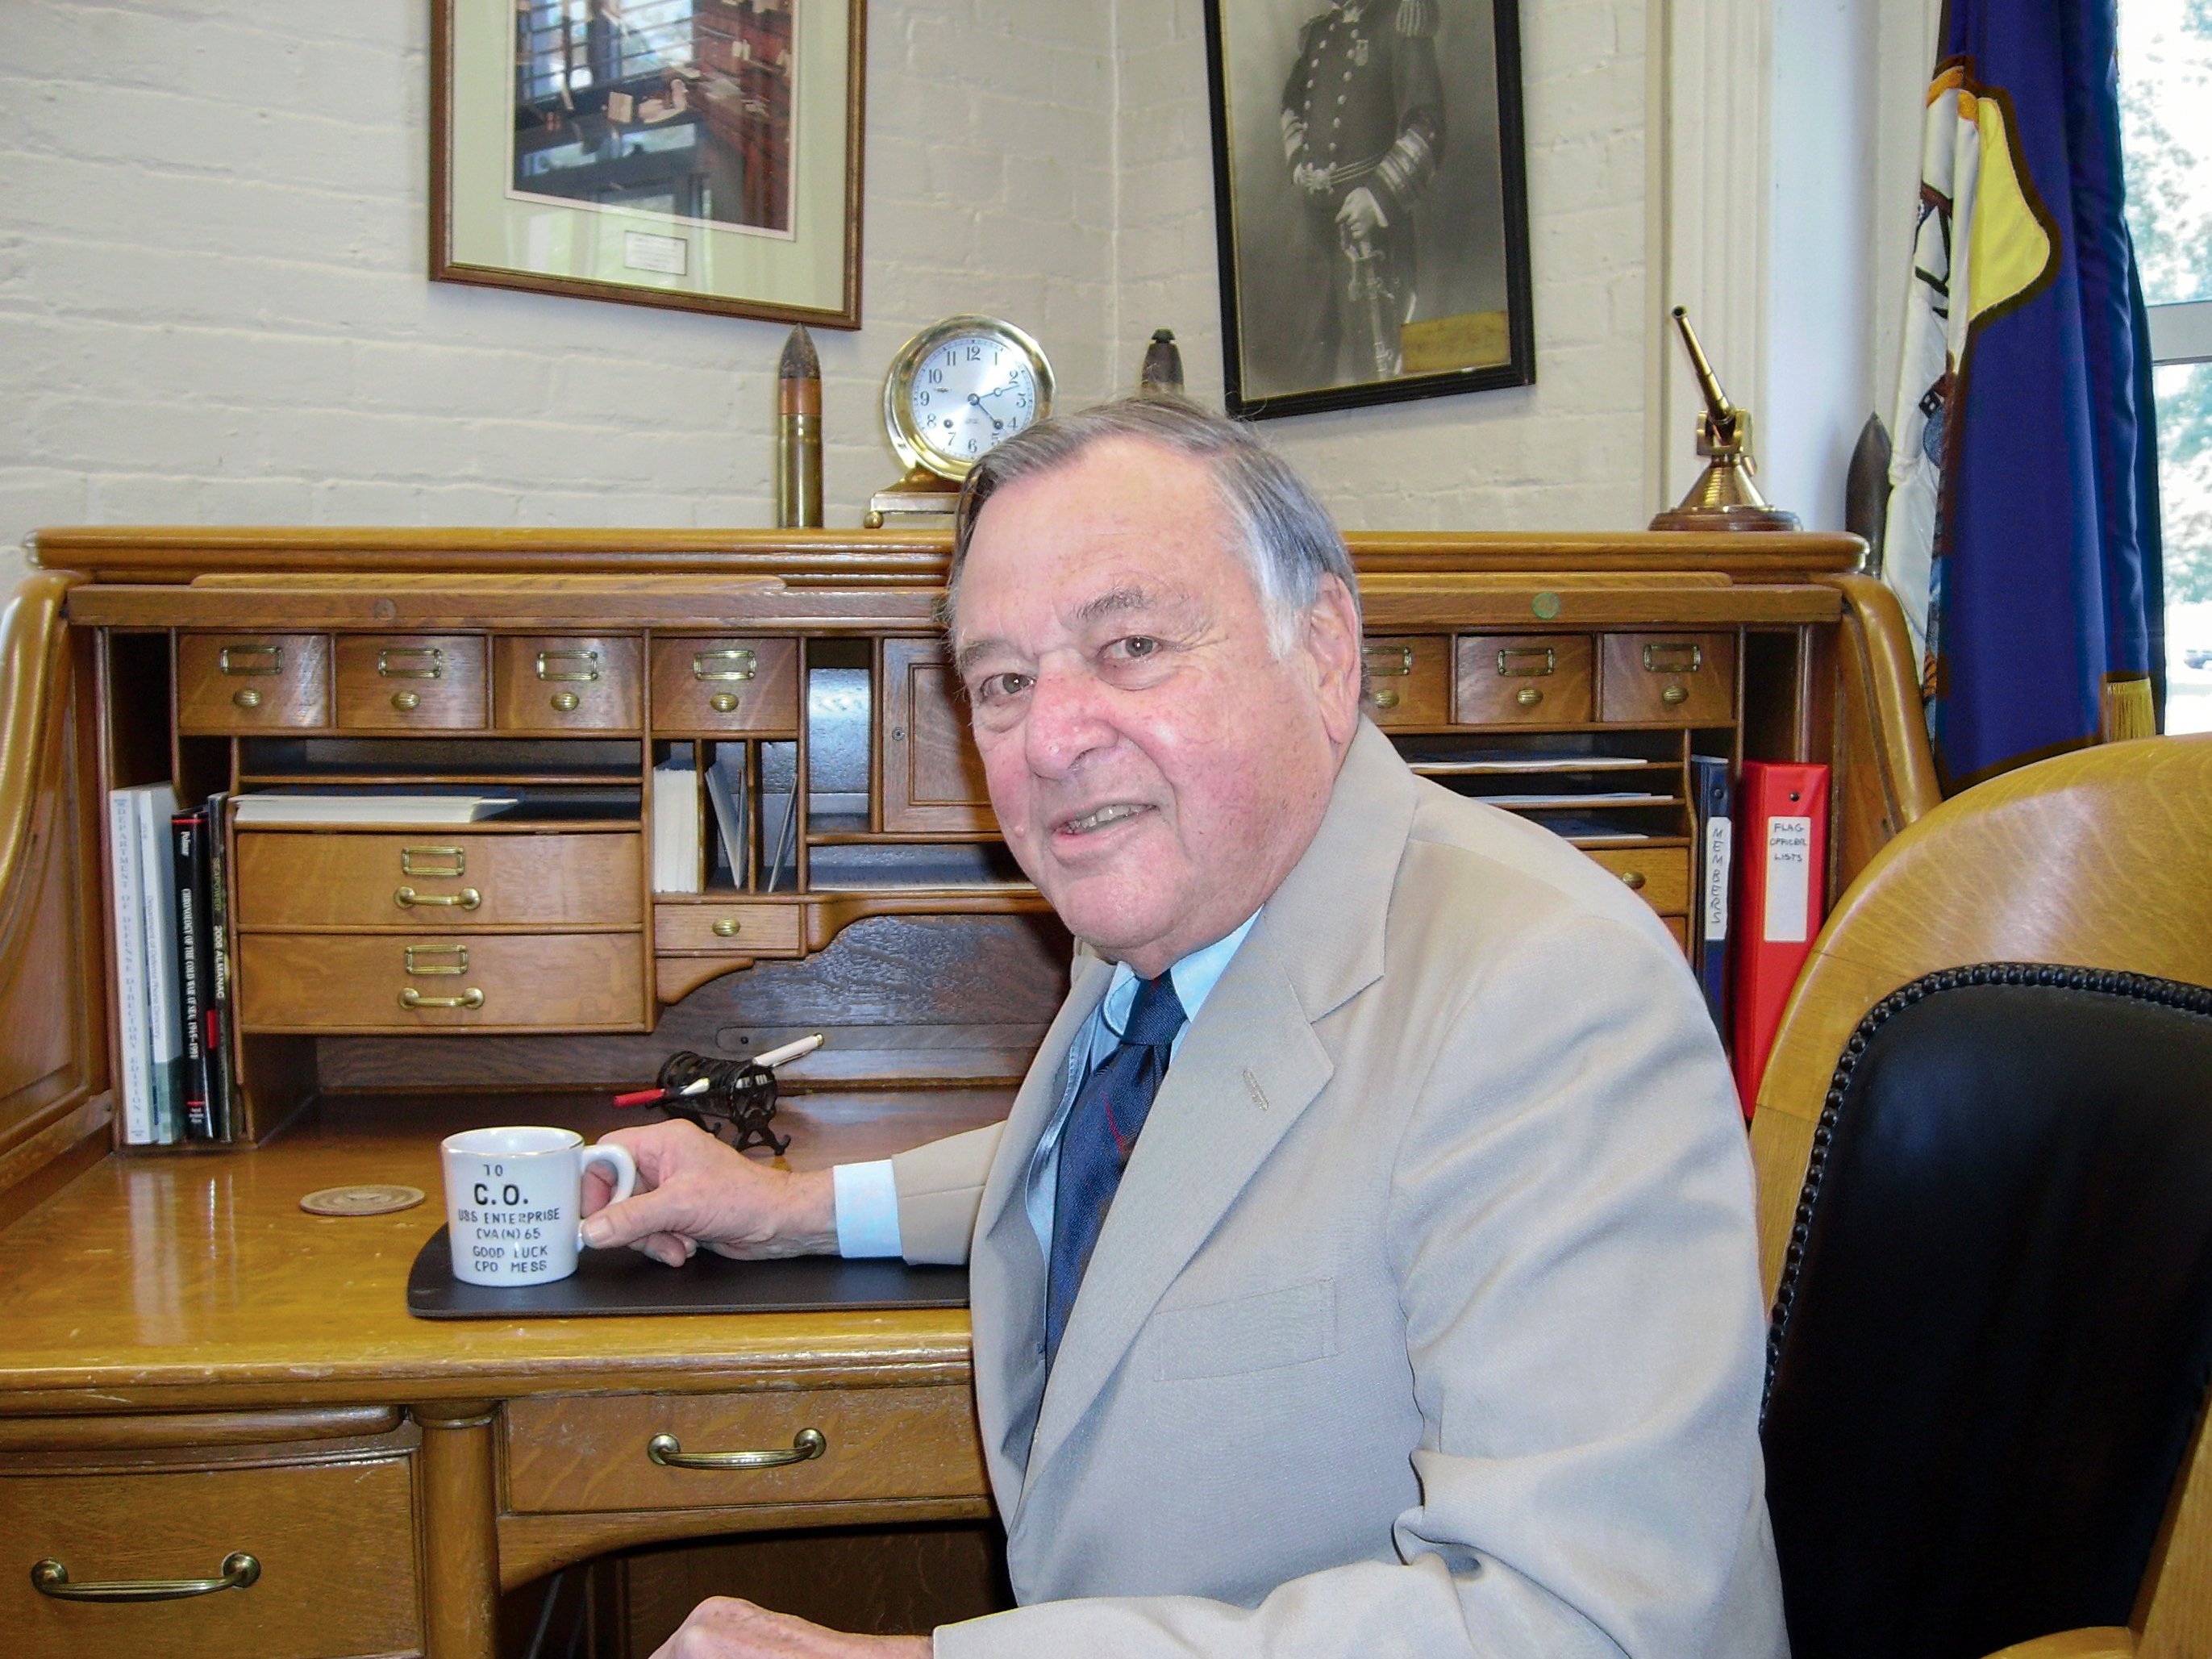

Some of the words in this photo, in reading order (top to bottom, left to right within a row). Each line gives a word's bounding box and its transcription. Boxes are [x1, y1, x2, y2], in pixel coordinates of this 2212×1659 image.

[947, 351, 956, 365] 11
[967, 346, 981, 361] 12
[994, 352, 998, 365] 1
[929, 369, 942, 384] 10
[1010, 370, 1019, 384] 2
[920, 391, 930, 406] 9
[1016, 394, 1027, 407] 3
[927, 414, 936, 427] 8
[1008, 417, 1018, 431] 4
[948, 432, 956, 446] 7
[968, 439, 977, 453] 6
[991, 433, 1001, 445] 5
[1774, 823, 1804, 832] FLAG
[1774, 853, 1803, 862] LISTS
[1710, 827, 1724, 924] MEMBERS
[213, 858, 222, 911] SEAPOWER
[181, 888, 194, 934] CHRONOLOGY
[184, 936, 194, 945] OF
[185, 946, 194, 960] THE
[185, 961, 195, 980] COLD
[215, 950, 225, 999] ALMANAC
[187, 981, 196, 996] WAR
[483, 1165, 503, 1176] TO
[474, 1183, 528, 1205] C.O.
[458, 1209, 477, 1223] USS
[484, 1208, 560, 1223] ENTERPRISE
[524, 1228, 541, 1240] 65
[473, 1245, 504, 1258] GOOD
[514, 1245, 548, 1258] LUCK
[475, 1261, 498, 1273] CPO
[511, 1261, 547, 1273] MESS
